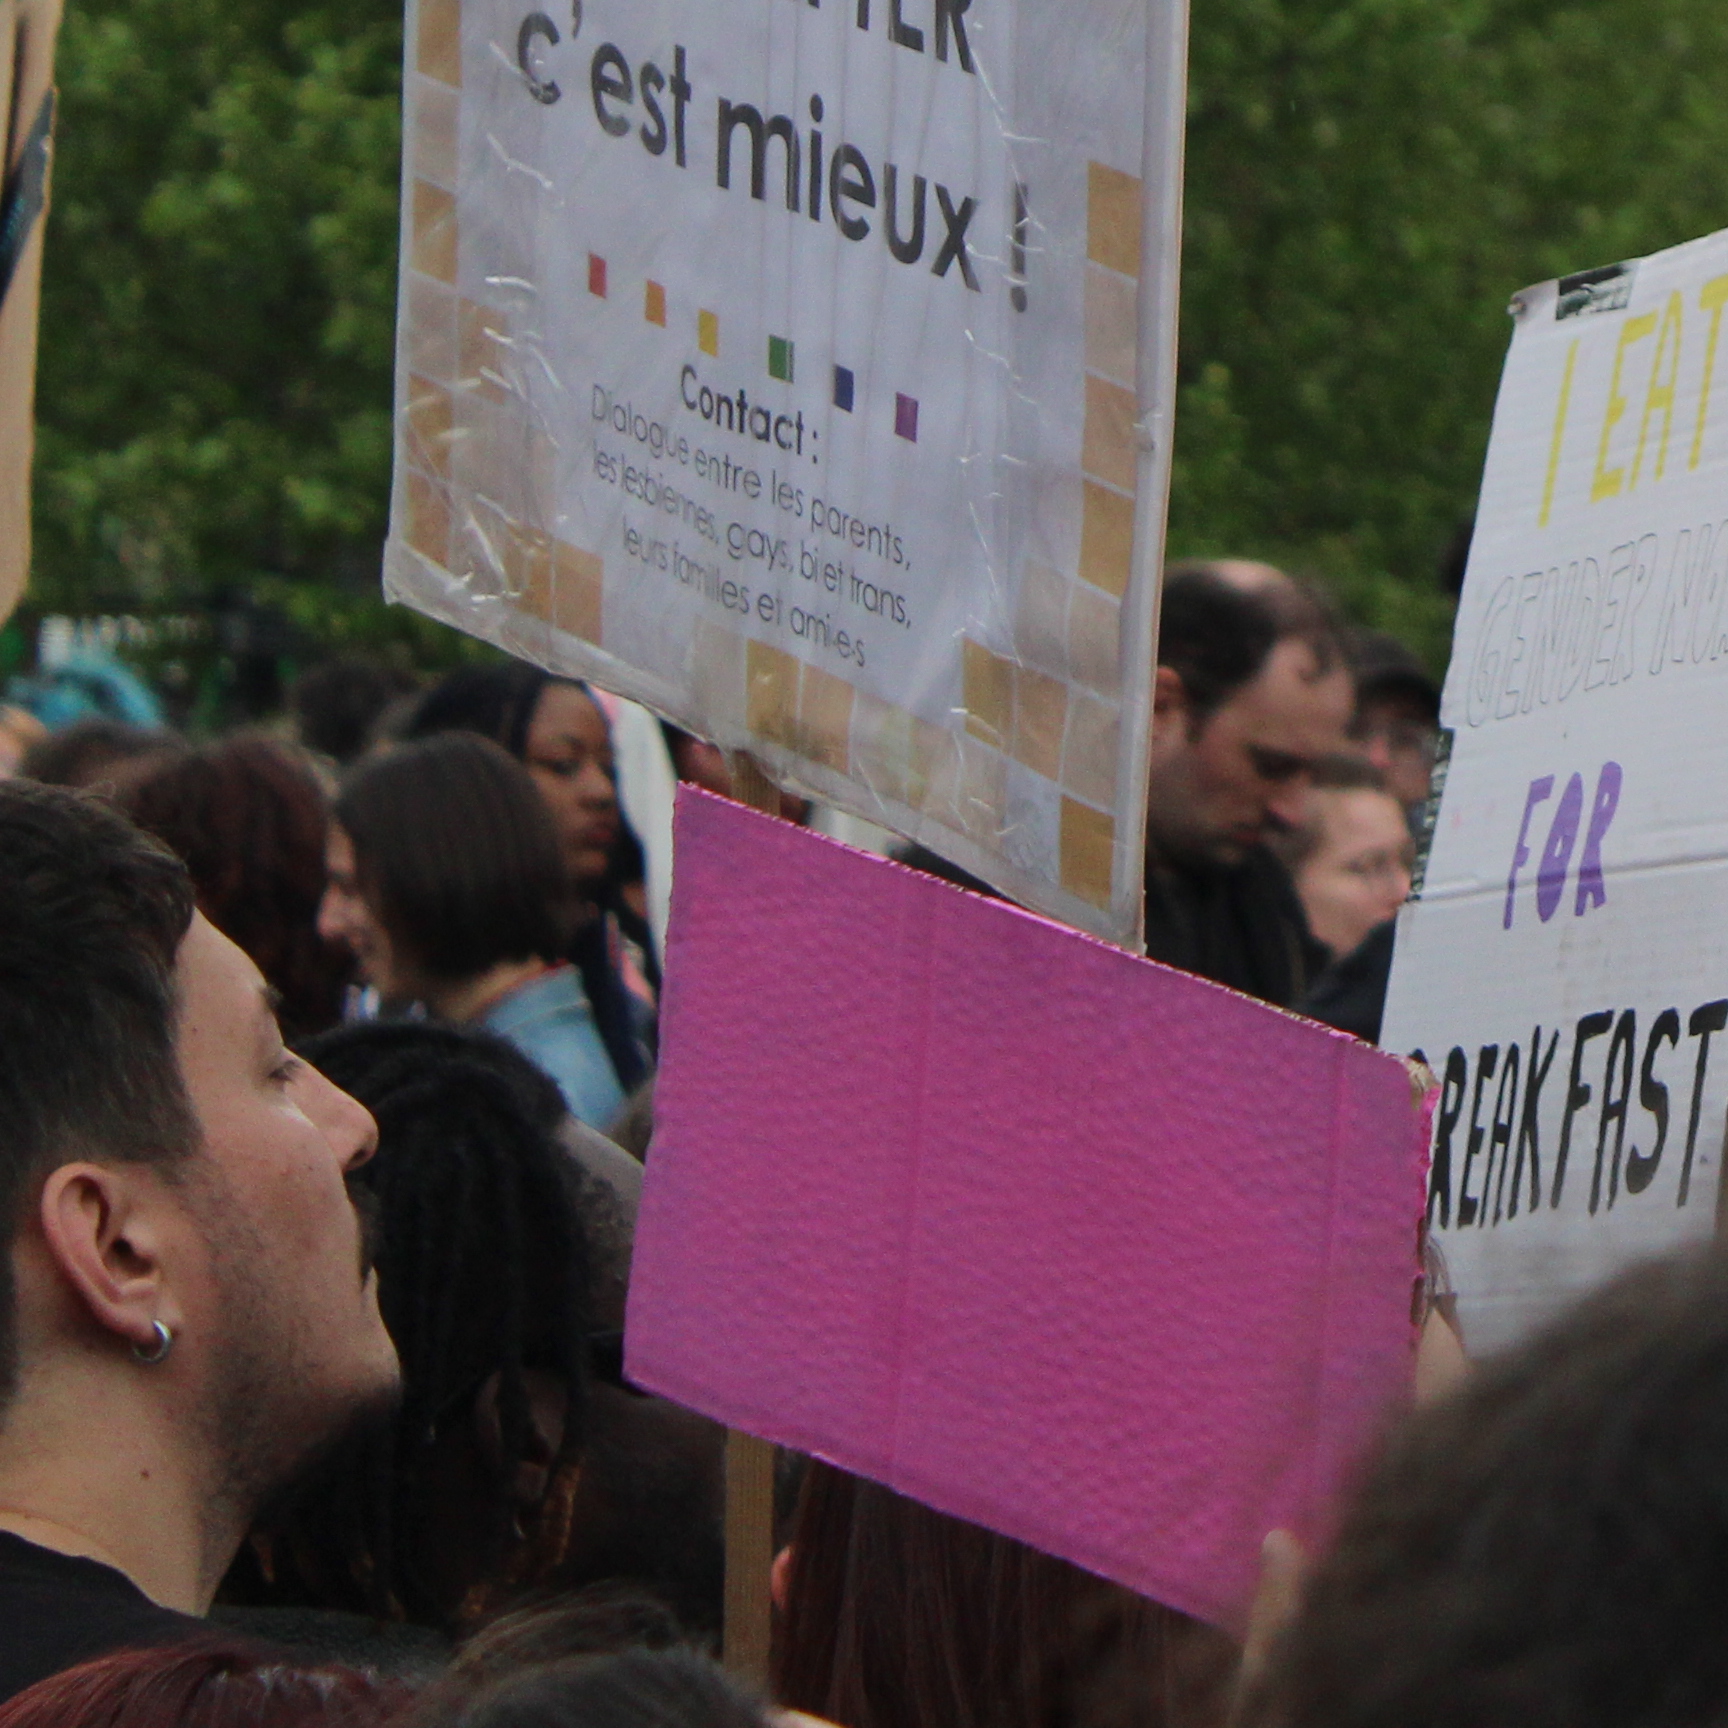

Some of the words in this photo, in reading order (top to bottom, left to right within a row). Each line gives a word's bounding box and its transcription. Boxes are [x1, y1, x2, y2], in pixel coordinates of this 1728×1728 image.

[716, 93, 982, 294] mieux
[591, 383, 690, 466] Dialogue
[694, 448, 762, 499] entre
[771, 469, 805, 517] les
[811, 496, 911, 571] parents,
[680, 363, 804, 456] Contact
[1537, 338, 1581, 529] I
[726, 521, 795, 574] gays,
[801, 539, 820, 582] bi
[823, 560, 843, 593] et
[850, 570, 912, 630] trans,
[757, 589, 783, 626] et
[1466, 532, 1659, 728] GENDER
[1502, 760, 1624, 931] FOR
